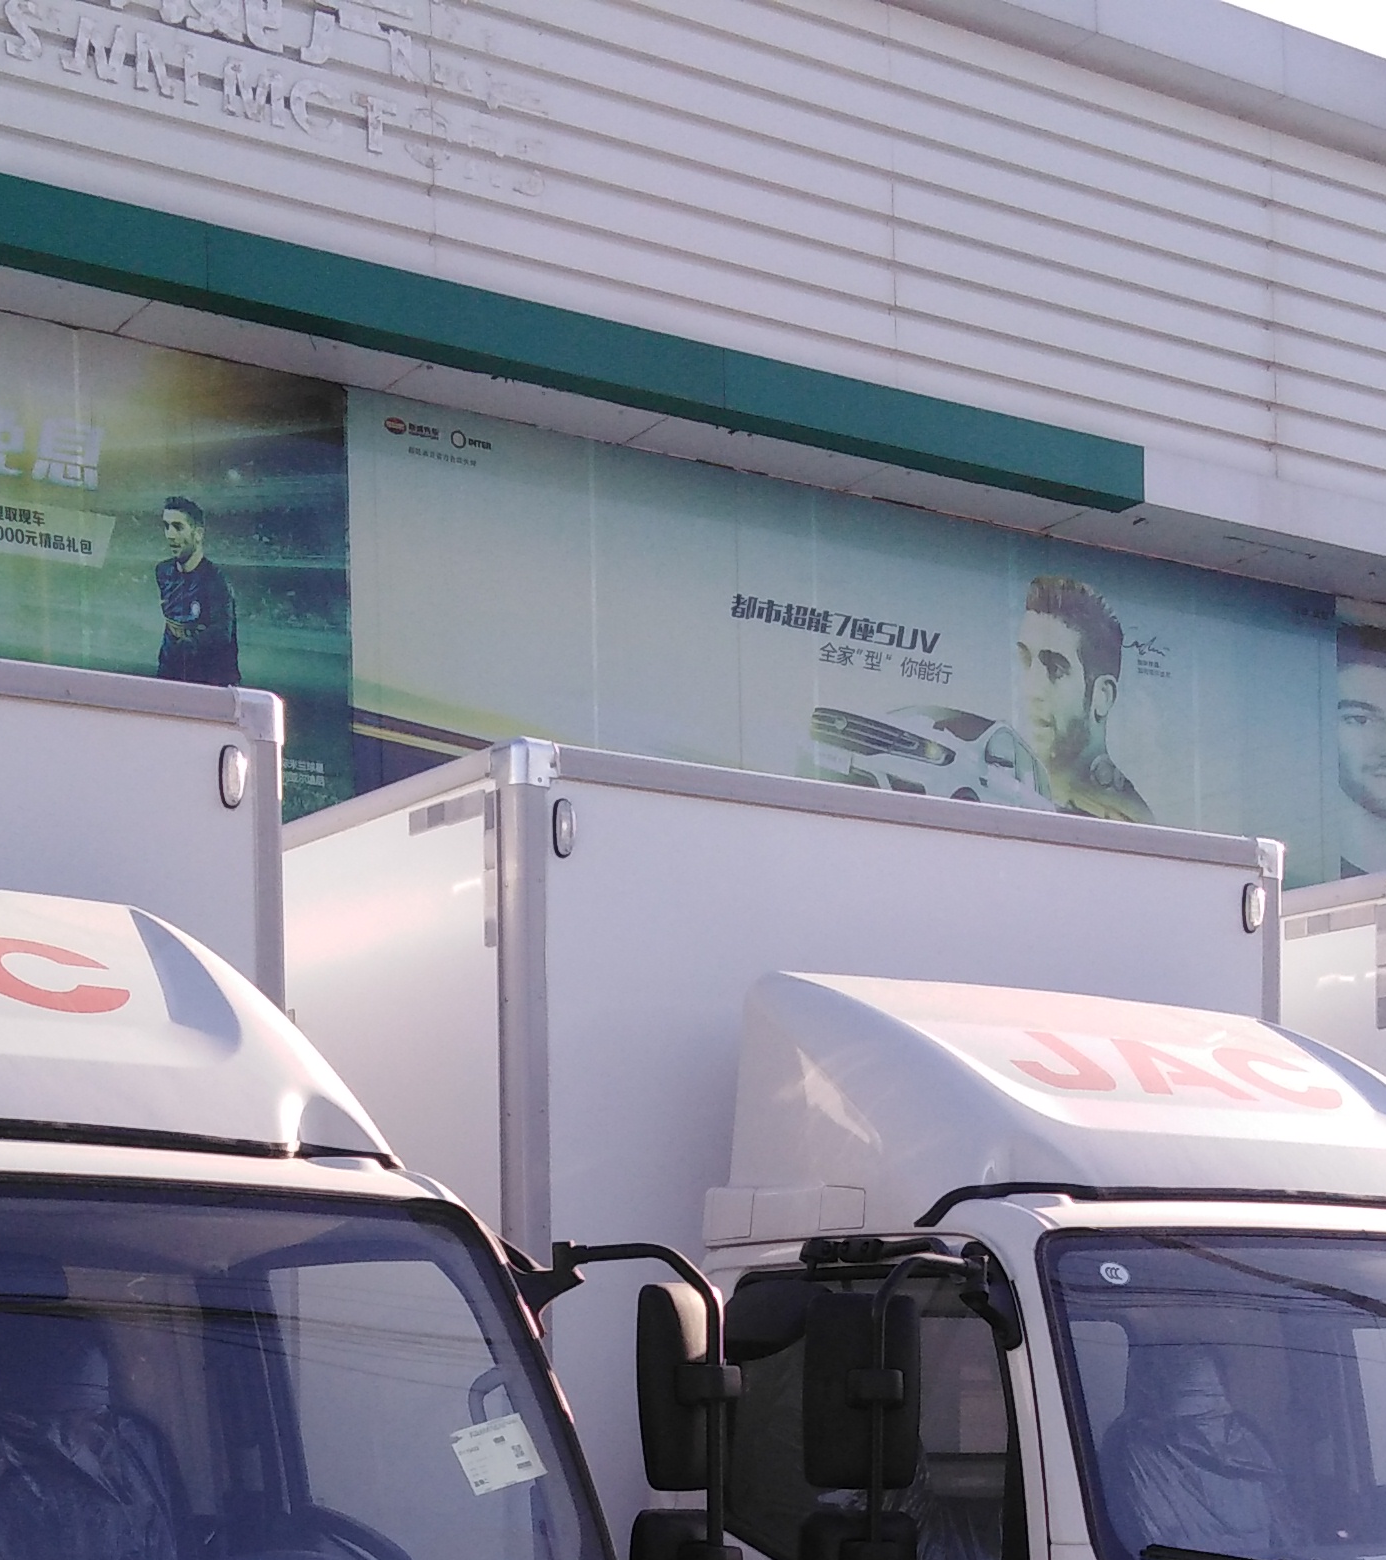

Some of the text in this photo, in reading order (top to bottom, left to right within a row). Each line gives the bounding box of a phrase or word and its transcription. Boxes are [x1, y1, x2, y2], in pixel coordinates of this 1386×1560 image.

[730, 593, 941, 654] 都市超能7座SUV
[1010, 1031, 1342, 1109] JAC
